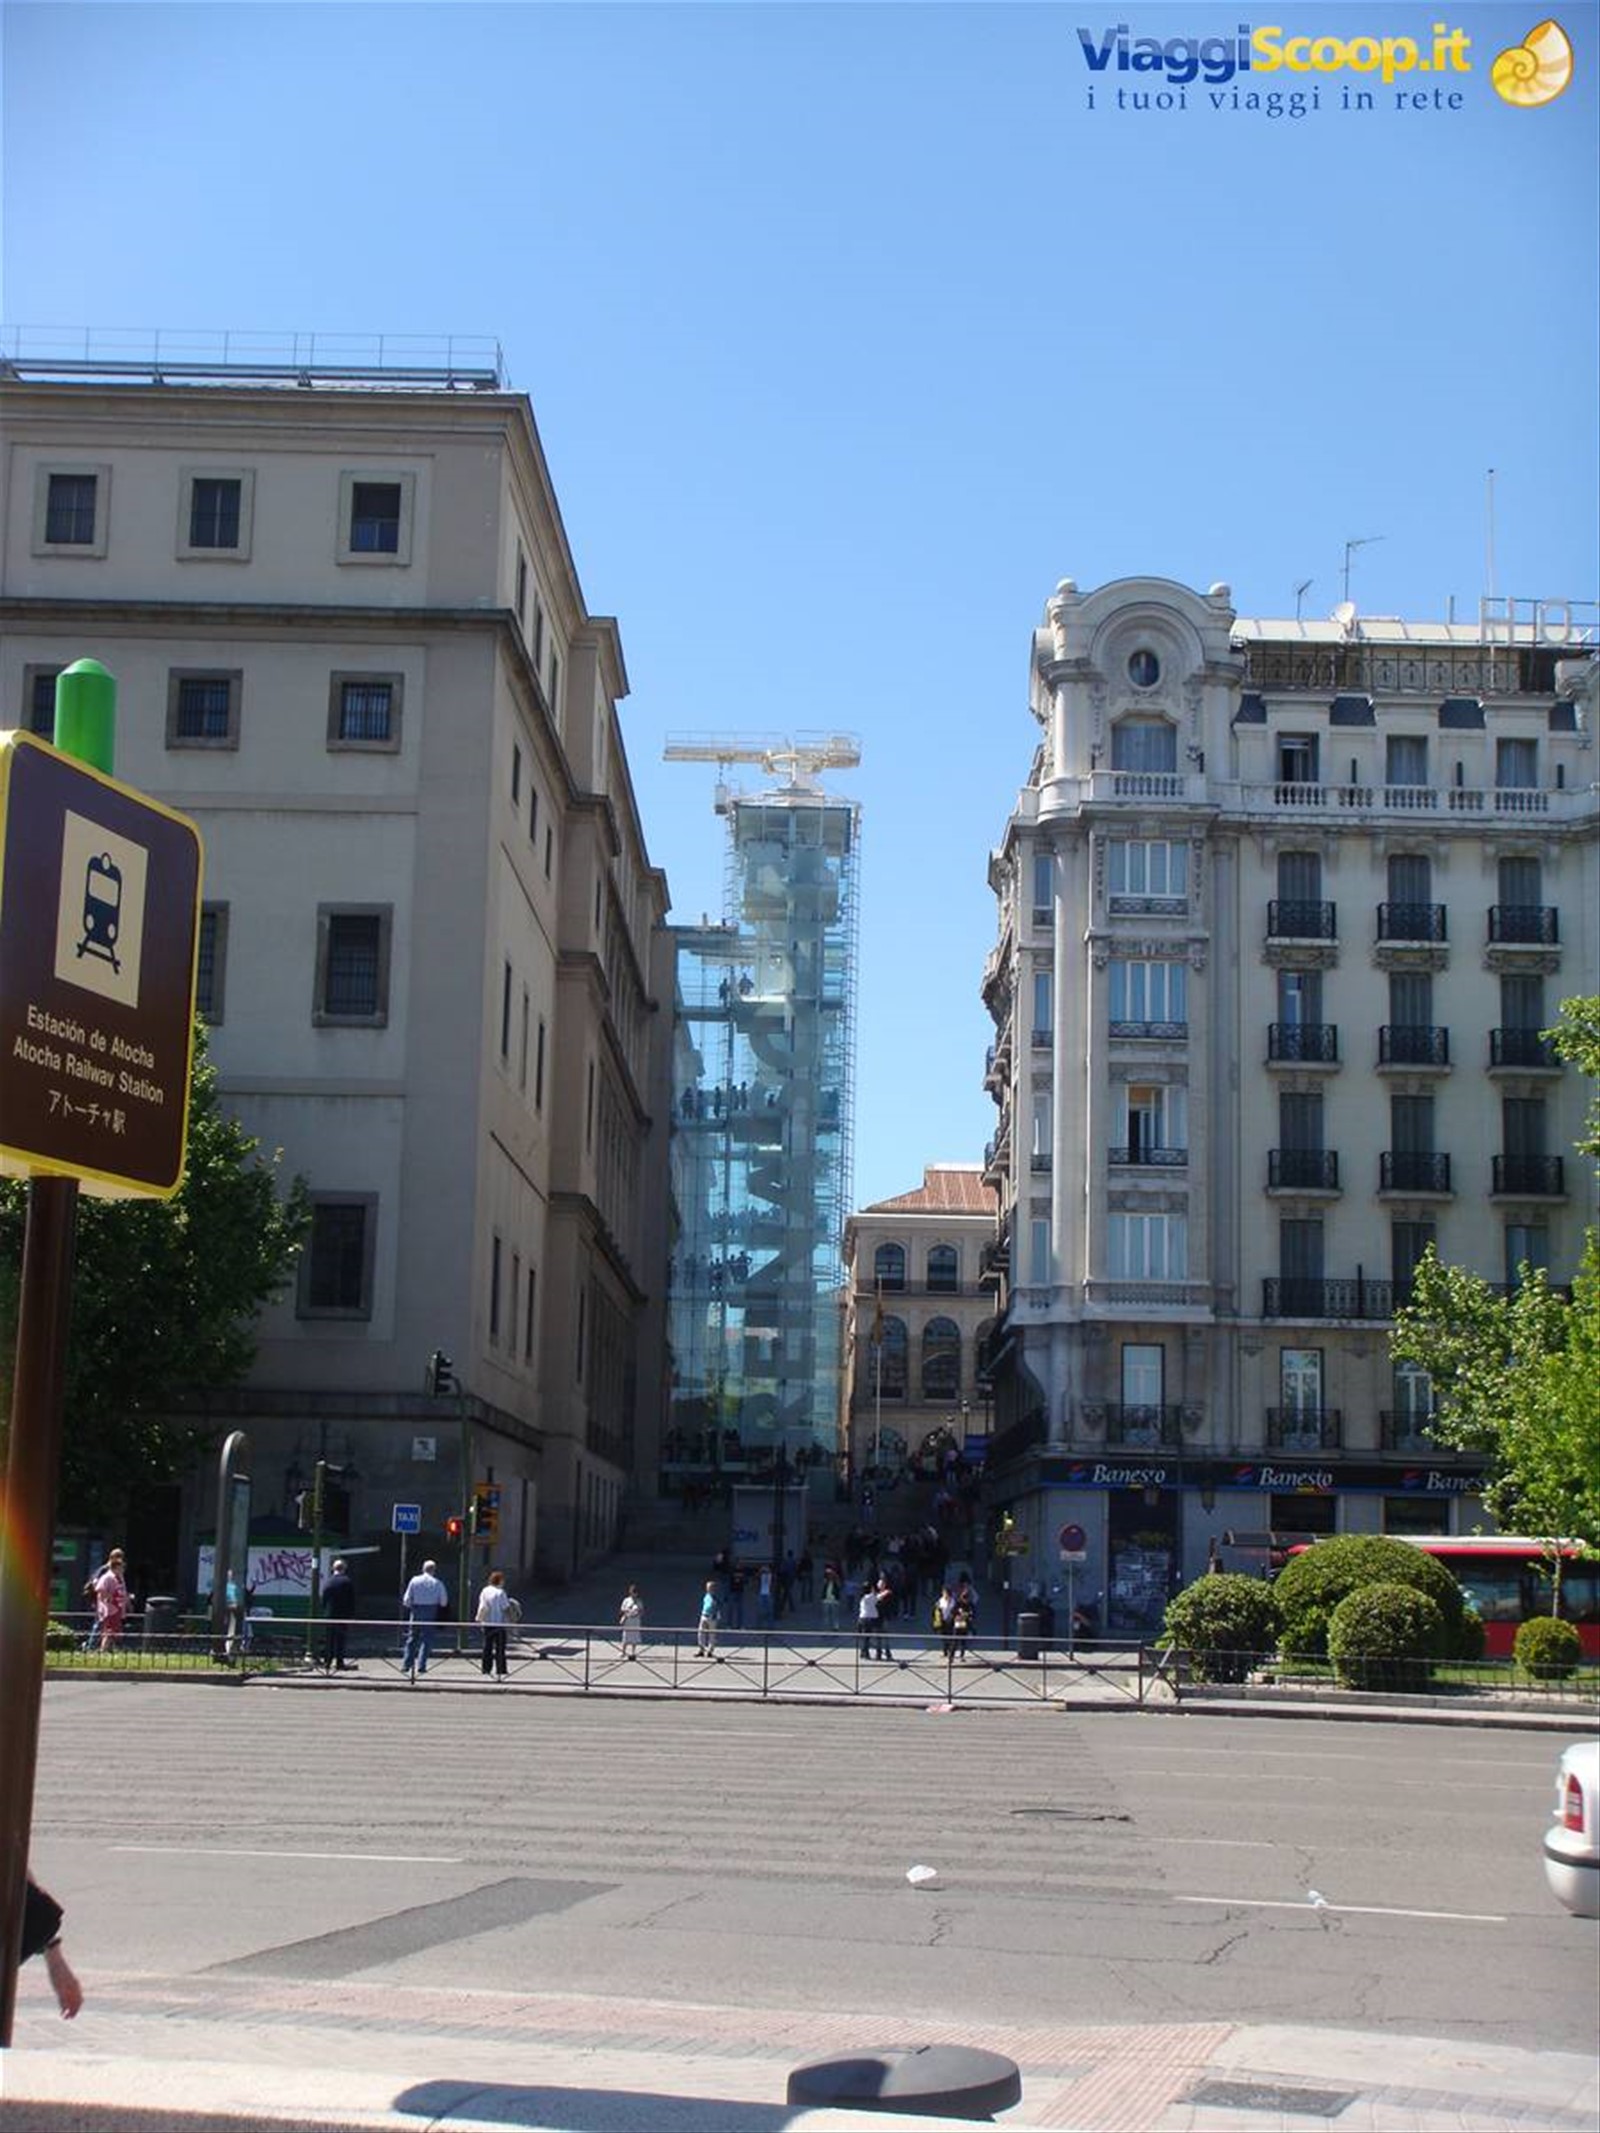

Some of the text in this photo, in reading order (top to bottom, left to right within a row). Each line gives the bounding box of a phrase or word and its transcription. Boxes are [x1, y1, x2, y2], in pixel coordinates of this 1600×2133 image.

[1479, 597, 1599, 647] HO
[26, 1003, 155, 1069] Estación de Atocha
[12, 1036, 164, 1105] Atocha Railway Station
[48, 1089, 127, 1134] アトーチャ駅
[1259, 1466, 1334, 1489] Banesto
[1426, 1470, 1492, 1491] Banes
[397, 1512, 418, 1522] TAXI
